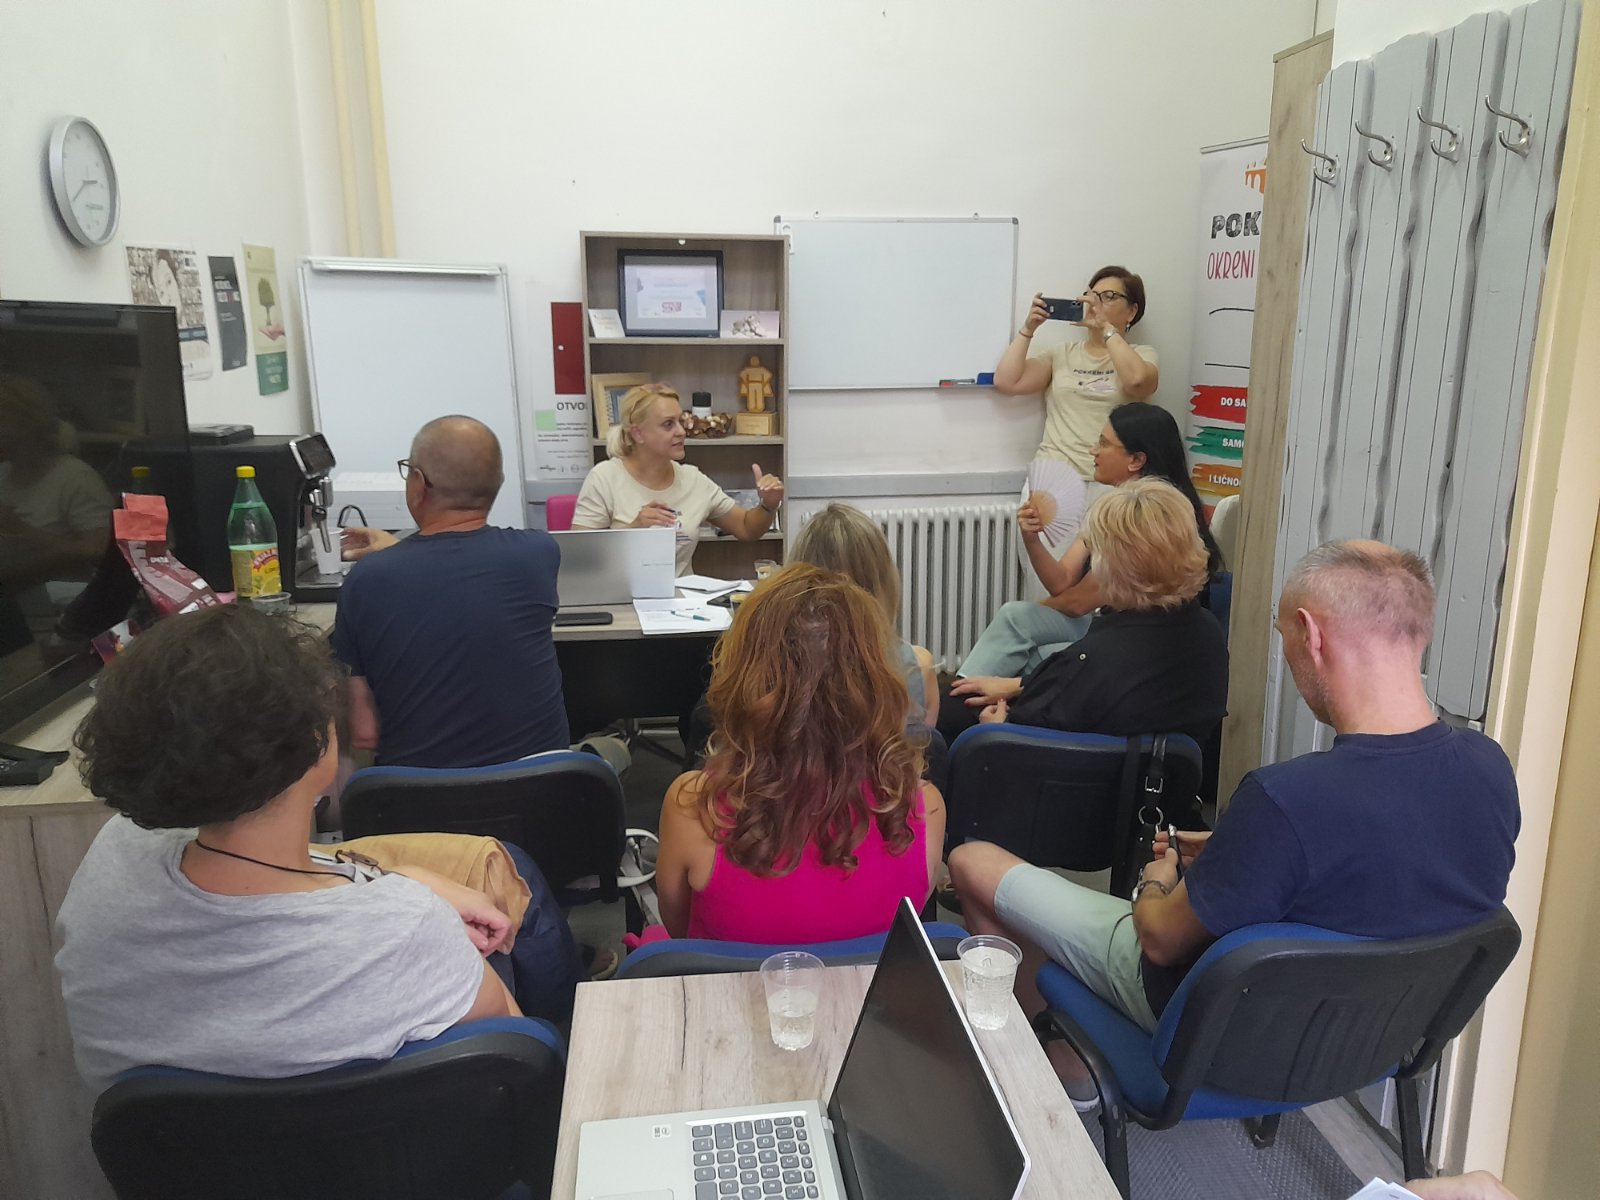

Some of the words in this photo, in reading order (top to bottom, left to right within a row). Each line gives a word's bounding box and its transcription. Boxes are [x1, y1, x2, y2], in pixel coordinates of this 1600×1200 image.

[1210, 211, 1261, 239] POK
[1221, 397, 1233, 406] DO
[1234, 398, 1248, 408] SA
[1213, 474, 1240, 486] LIČNO
